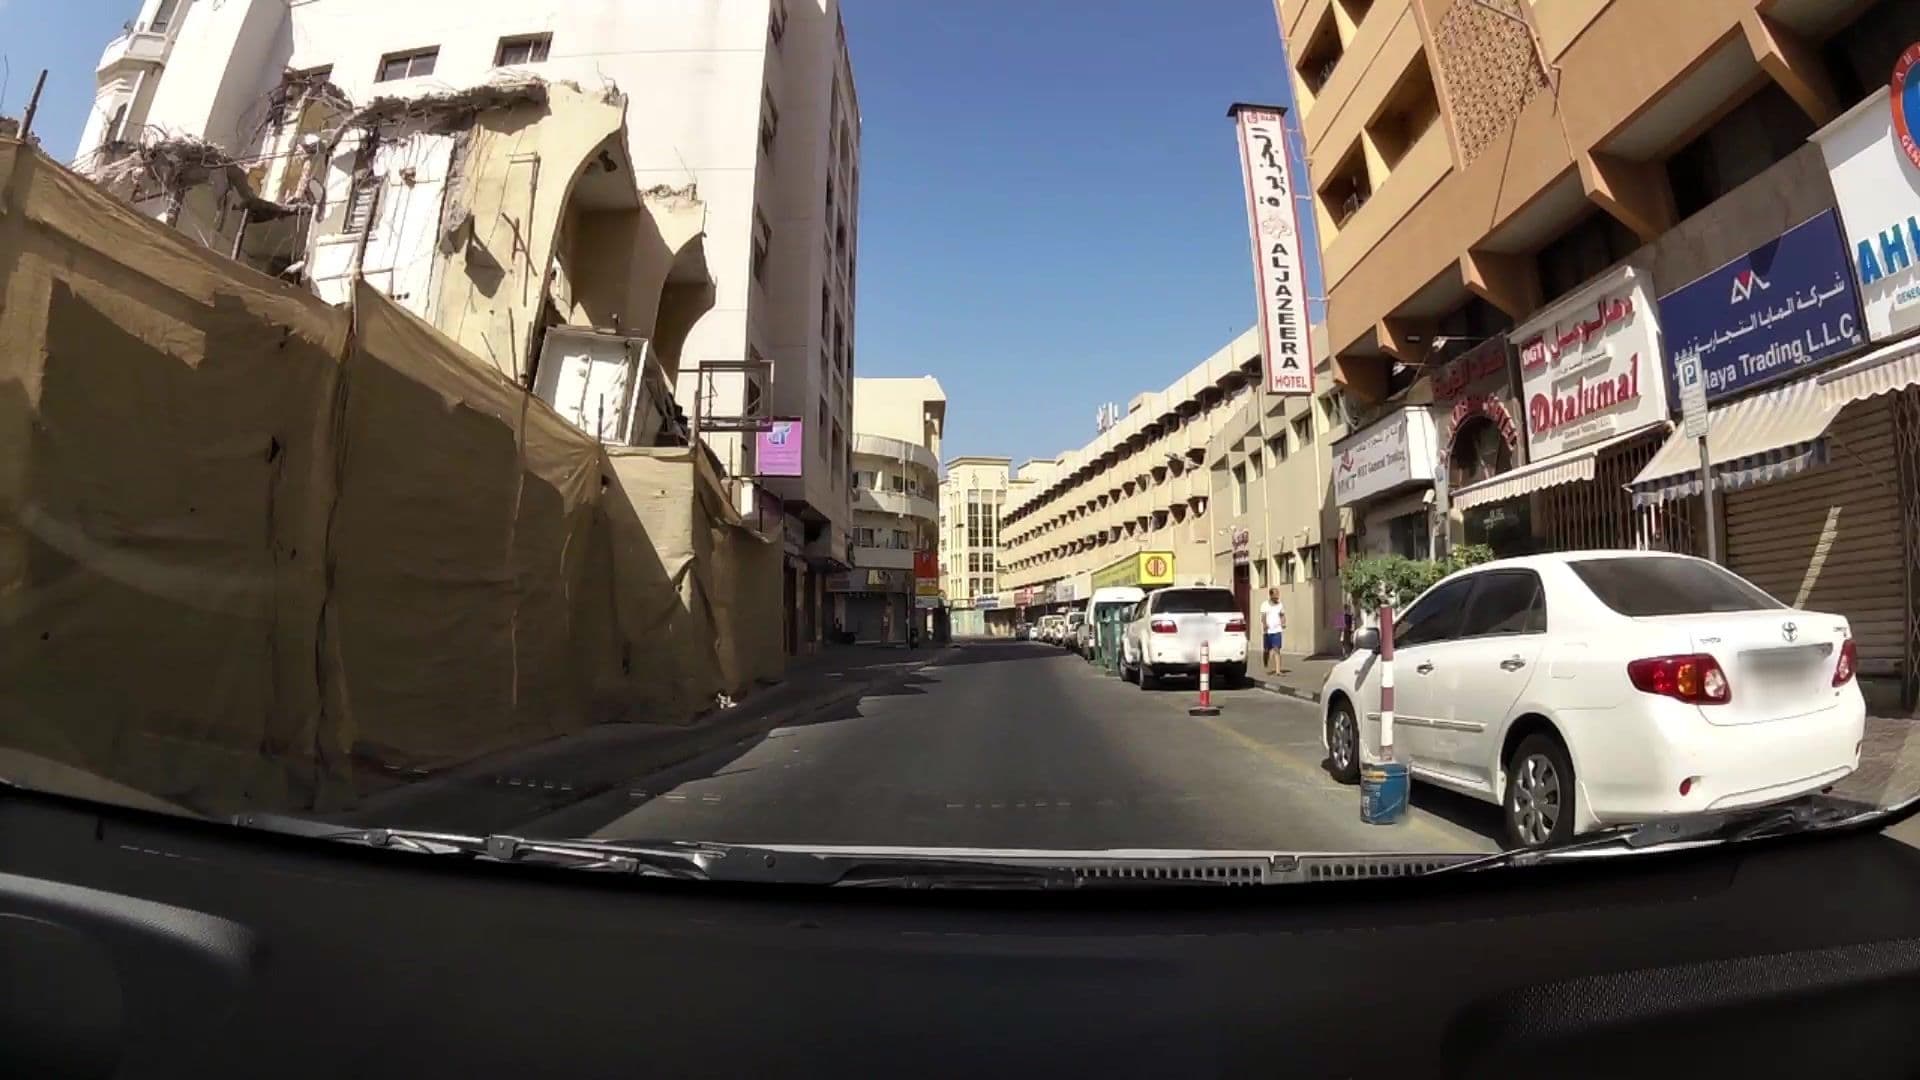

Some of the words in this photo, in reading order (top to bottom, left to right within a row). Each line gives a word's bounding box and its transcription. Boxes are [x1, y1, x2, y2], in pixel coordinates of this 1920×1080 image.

[1271, 243, 1299, 370] ALJAZEERA
[1796, 271, 1845, 310] شركة
[1685, 364, 1695, 385] P
[1738, 340, 1803, 378] Trading
[1274, 375, 1307, 389] HOTEL
[1530, 351, 1641, 433] Dhalumal
